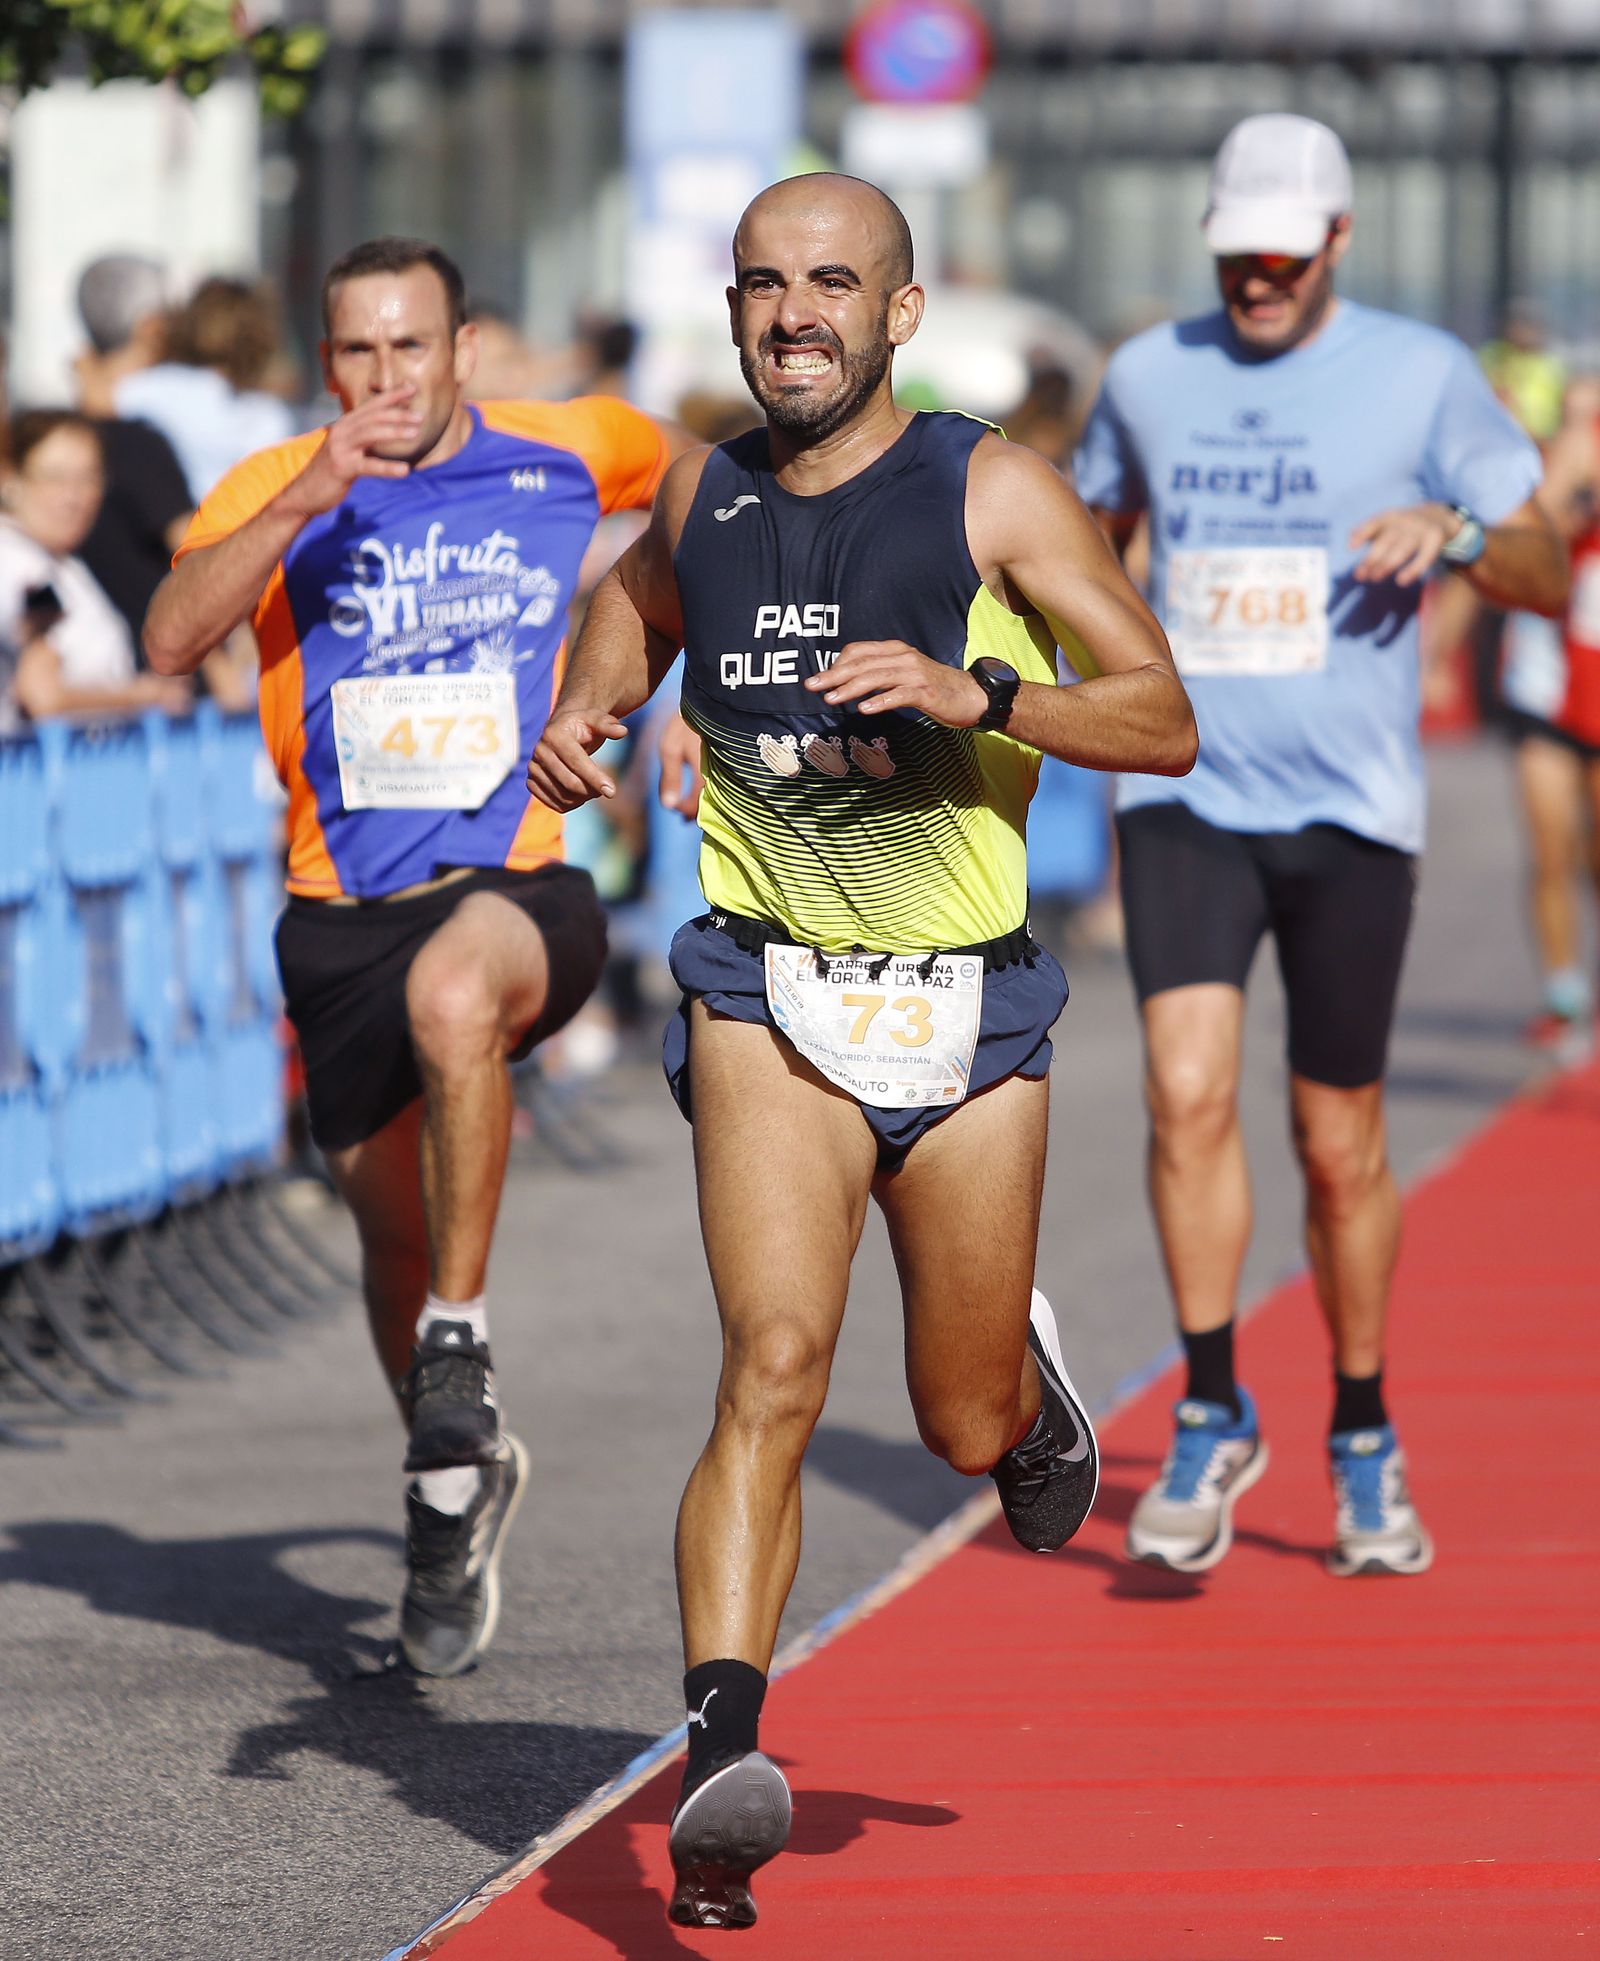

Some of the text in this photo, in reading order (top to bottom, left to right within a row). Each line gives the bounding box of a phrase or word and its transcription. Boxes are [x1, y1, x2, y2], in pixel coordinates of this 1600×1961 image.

[1171, 456, 1318, 506] nerja
[753, 603, 841, 639] PASO
[1207, 586, 1308, 626] 768
[719, 650, 841, 690] QUE V
[359, 695, 377, 706] EL
[442, 693, 461, 703] LA
[380, 714, 501, 759] 473
[376, 783, 448, 794] DISMOAUTO
[796, 969, 954, 989] EL TORCAL LA PAZ
[828, 959, 891, 972] CARREA
[896, 963, 954, 975] URBNA
[841, 993, 934, 1048] 73
[815, 1059, 889, 1093] DISMOAUTO
[876, 1055, 931, 1065] SEBASTIÁN
